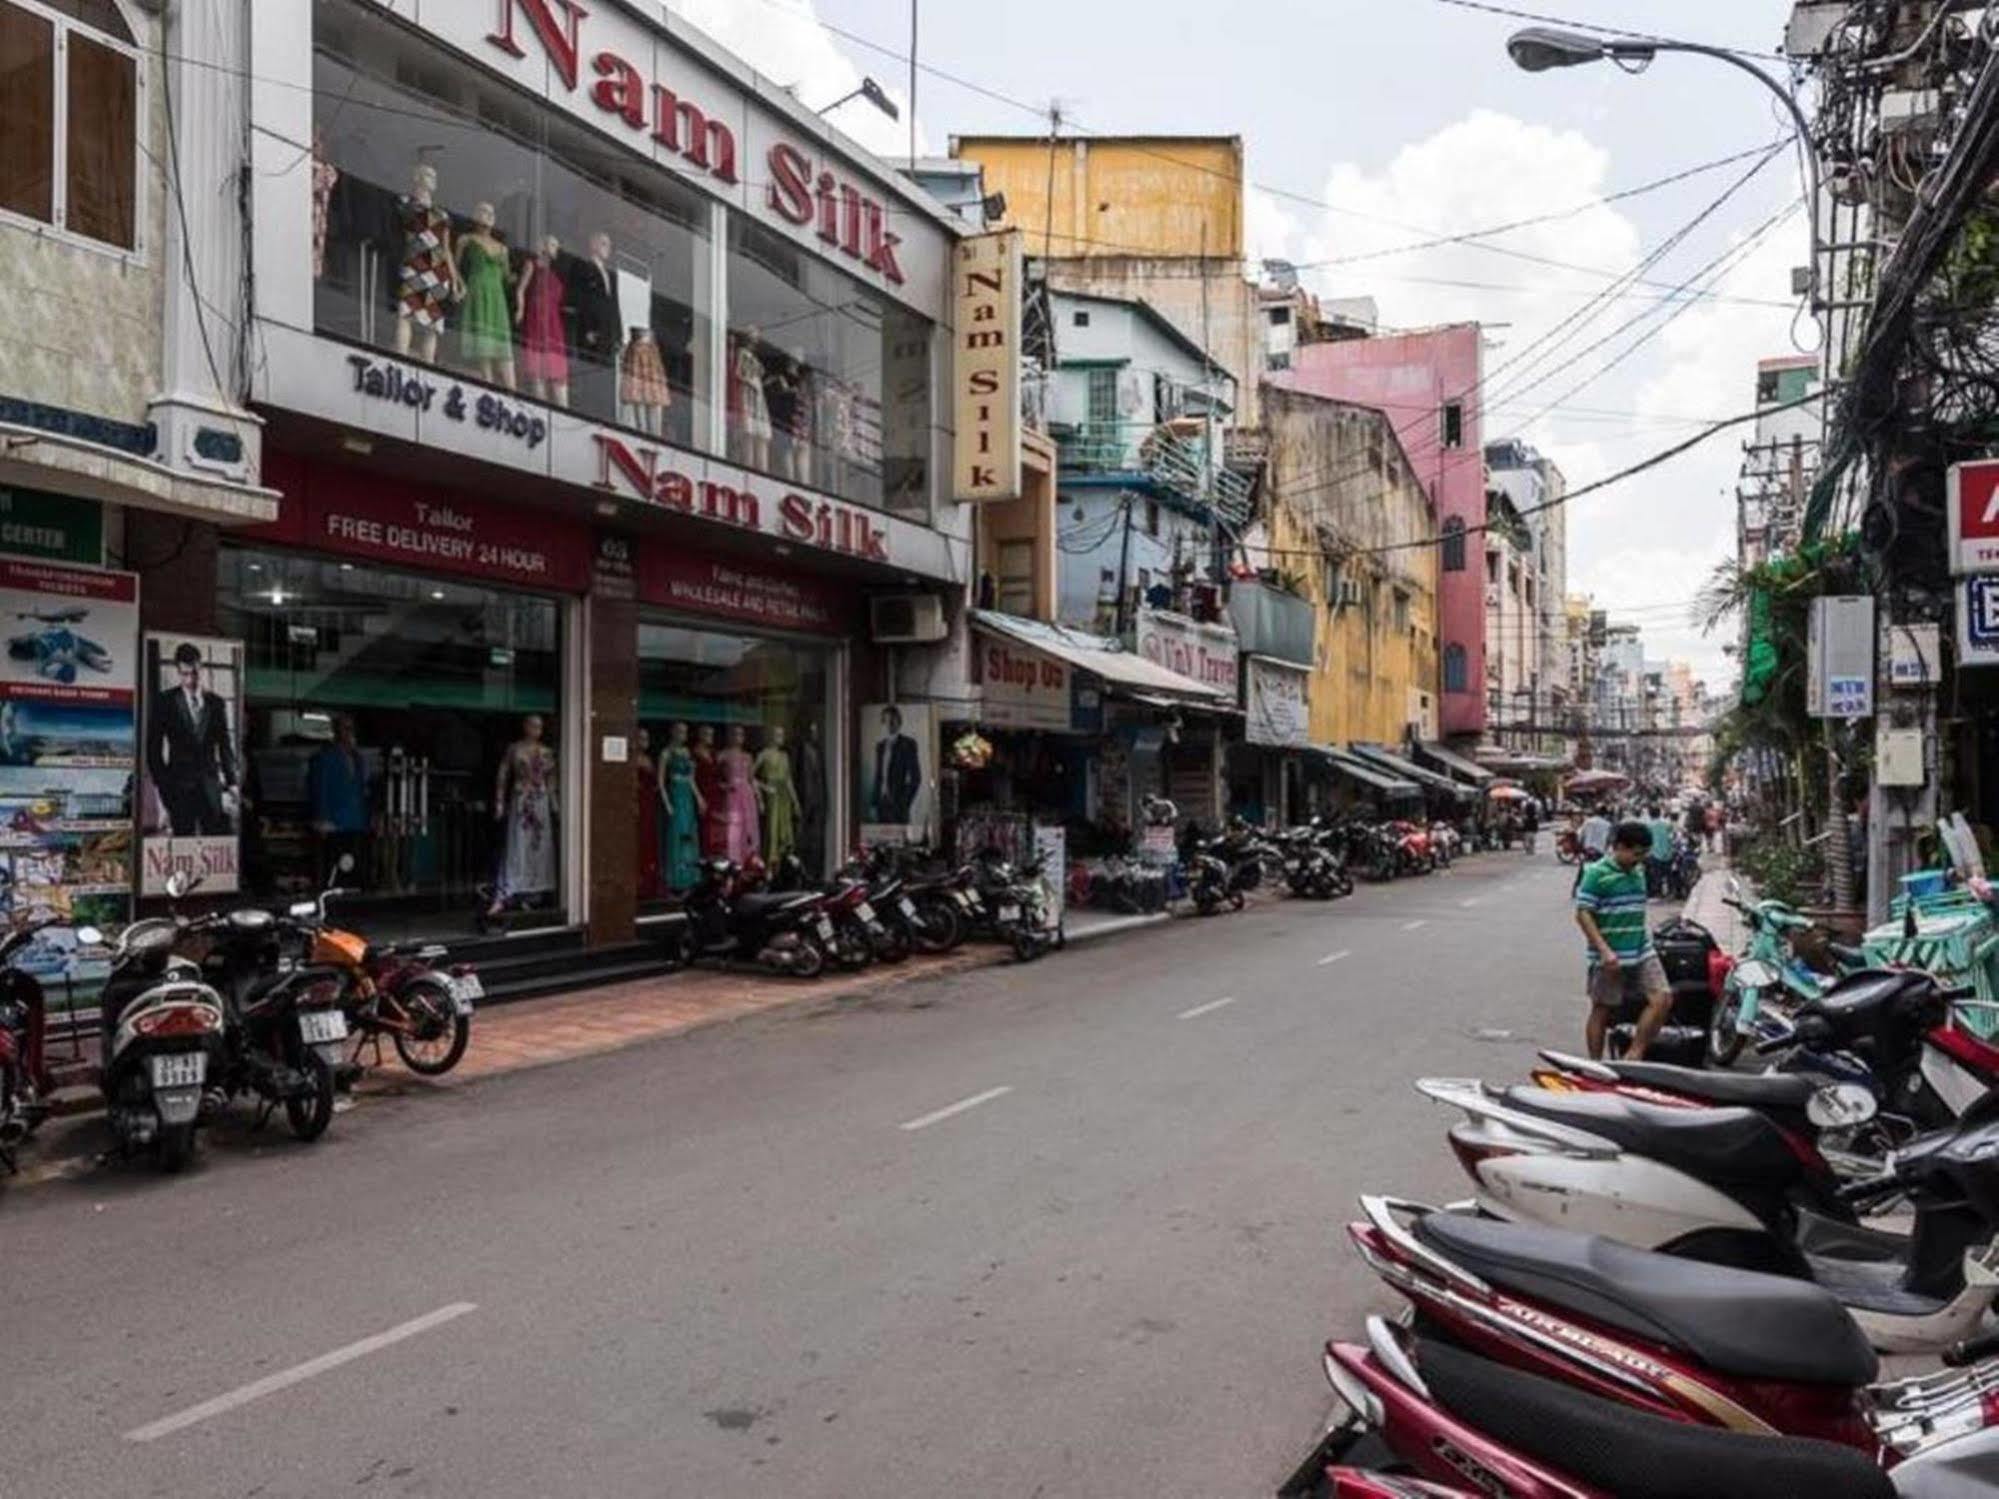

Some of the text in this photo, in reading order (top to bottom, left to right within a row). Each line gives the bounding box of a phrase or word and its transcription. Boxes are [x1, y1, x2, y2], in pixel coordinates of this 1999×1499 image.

[486, 0, 906, 285] Nam Silk
[963, 268, 1004, 350] Nam
[347, 354, 546, 450] Tailor & Shop
[969, 370, 1000, 489] Silk
[414, 500, 474, 532] Tailor
[591, 433, 890, 563] Nam Silk
[327, 513, 547, 574] FREE DELIVERY 24 HOUR
[988, 647, 1038, 693] Shop
[146, 844, 238, 878] Nam Silk
